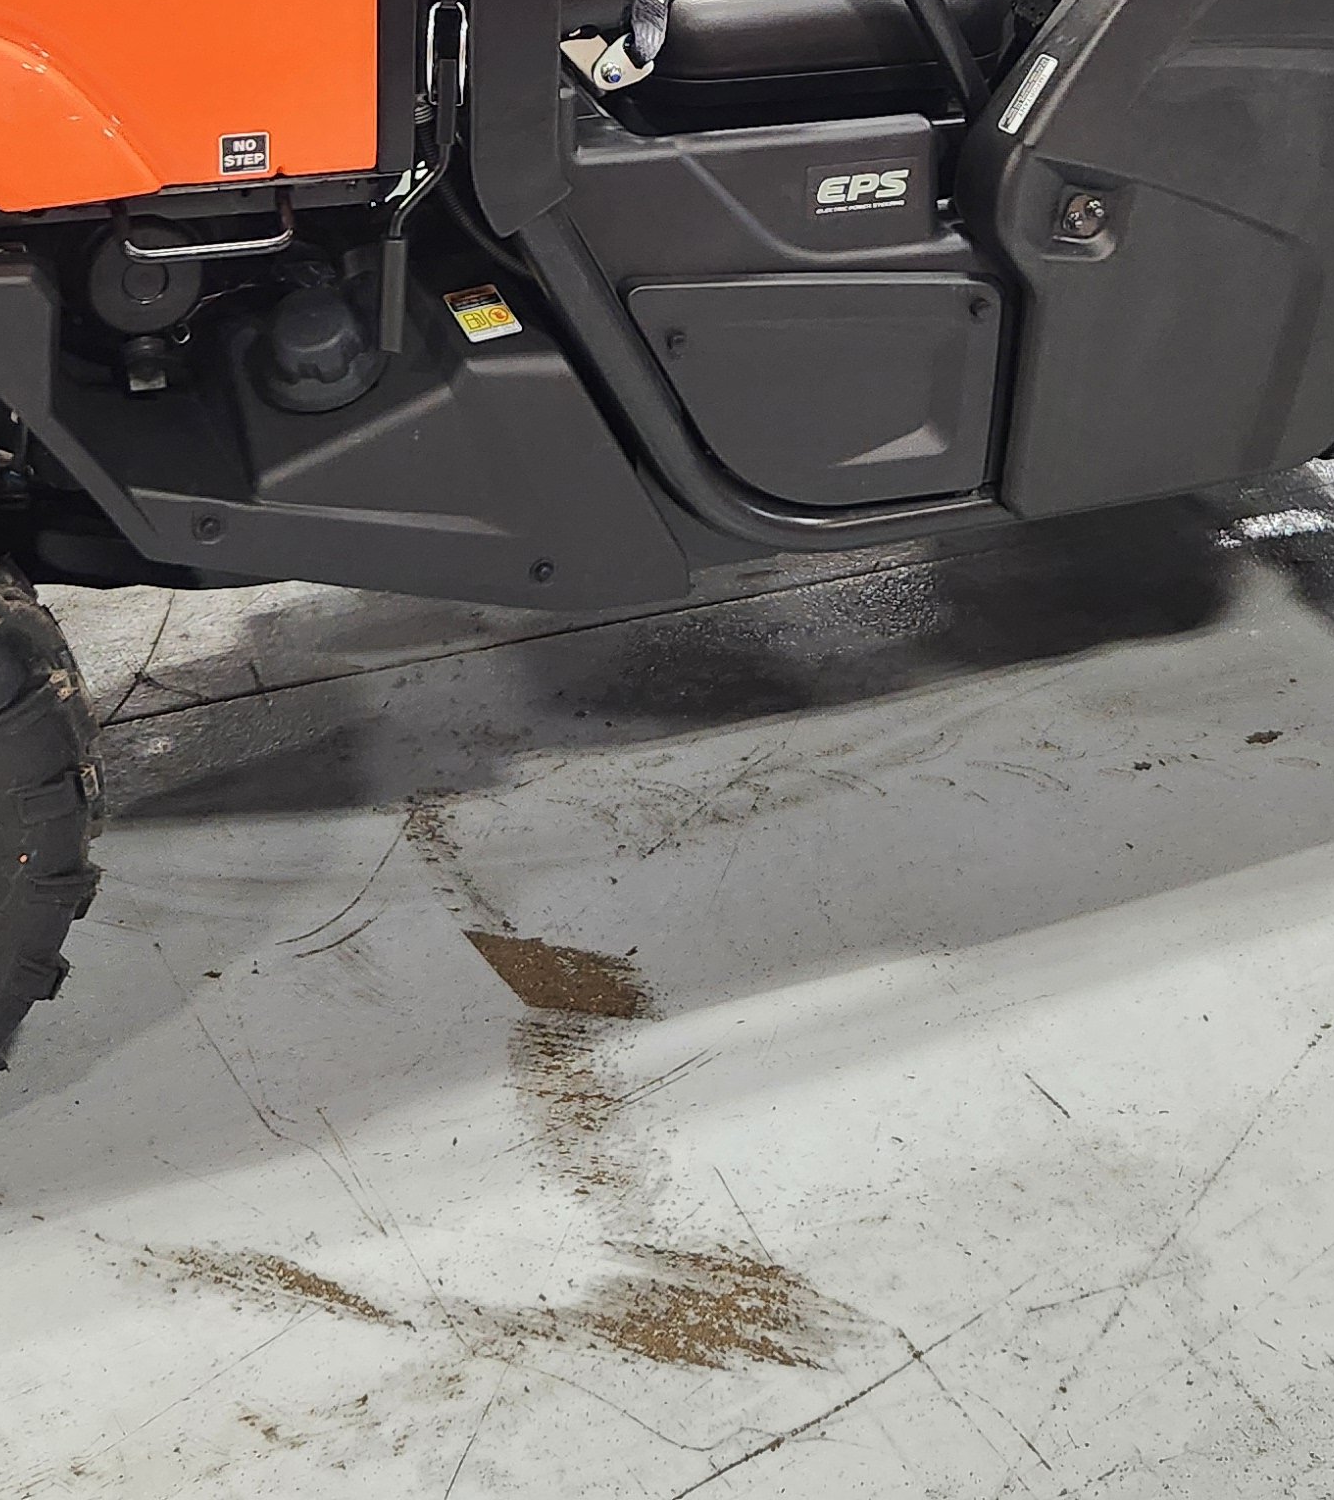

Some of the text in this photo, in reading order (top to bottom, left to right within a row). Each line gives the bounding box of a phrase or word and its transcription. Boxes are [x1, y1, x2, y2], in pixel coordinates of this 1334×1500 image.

[232, 138, 257, 152] NO
[223, 152, 265, 167] STEP
[817, 169, 910, 204] EPS
